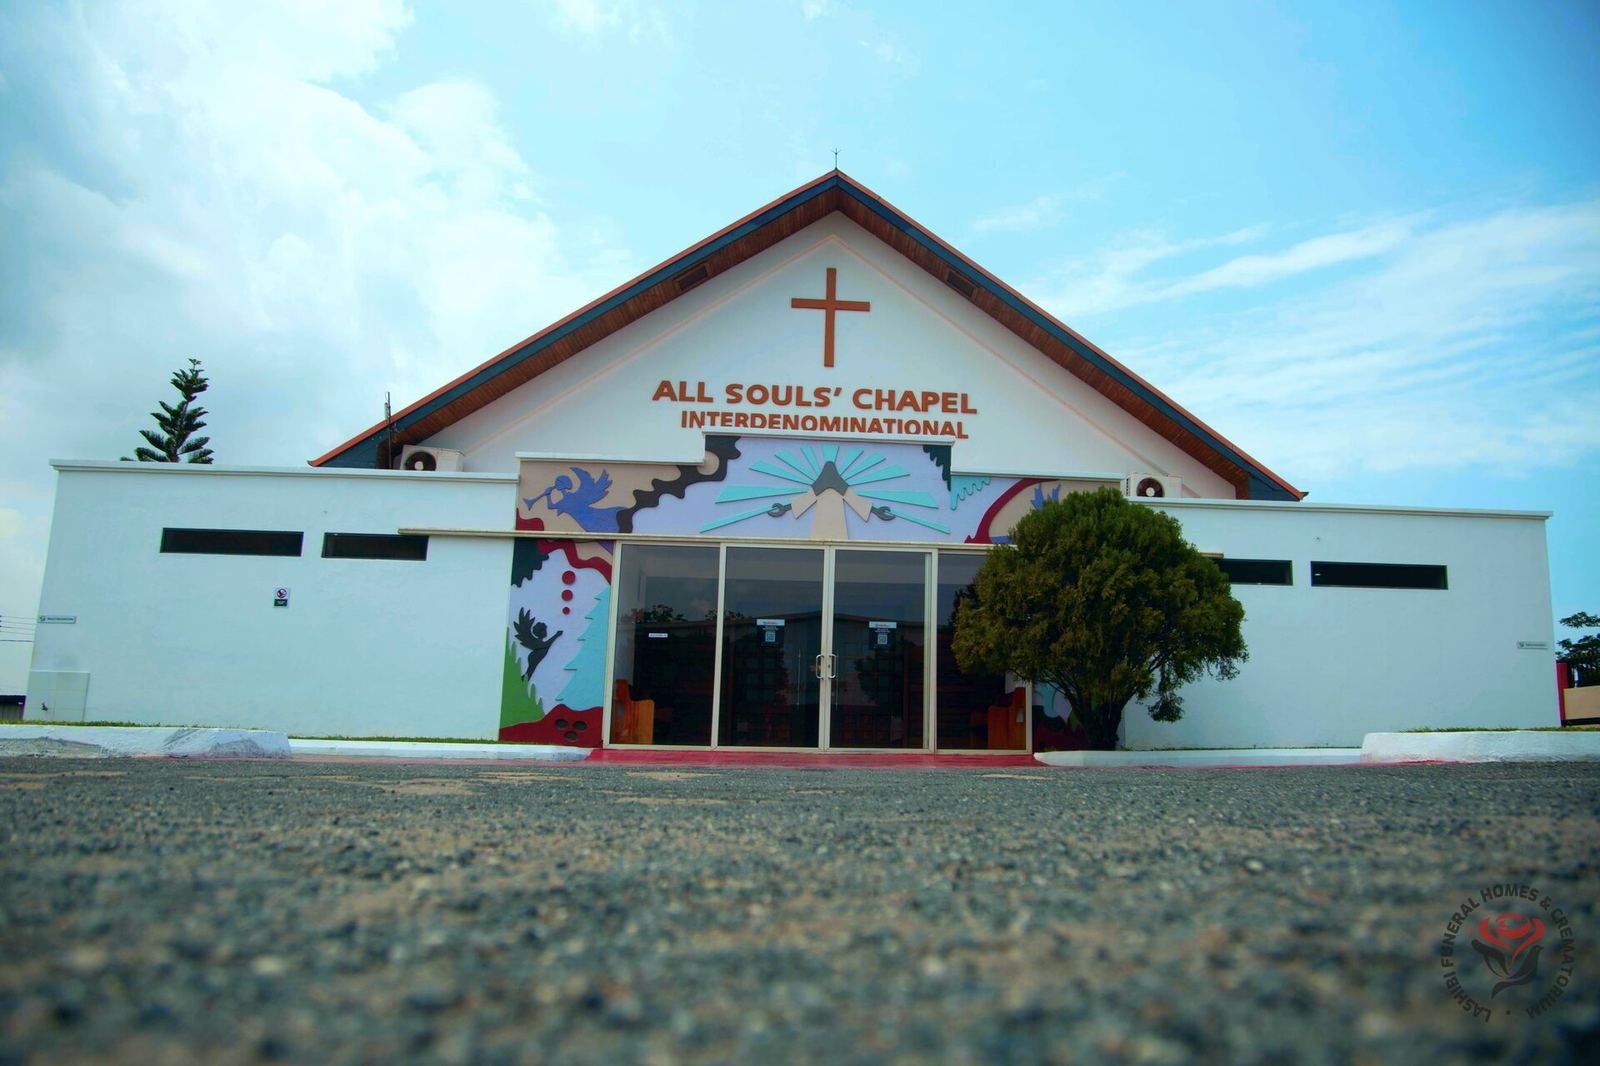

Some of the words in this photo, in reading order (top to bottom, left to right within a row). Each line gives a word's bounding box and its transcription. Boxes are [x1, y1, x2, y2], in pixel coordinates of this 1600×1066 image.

[652, 380, 714, 403] ALL
[852, 388, 978, 414] CHAPEL
[681, 410, 969, 439] INTERDENOMINATIONAL
